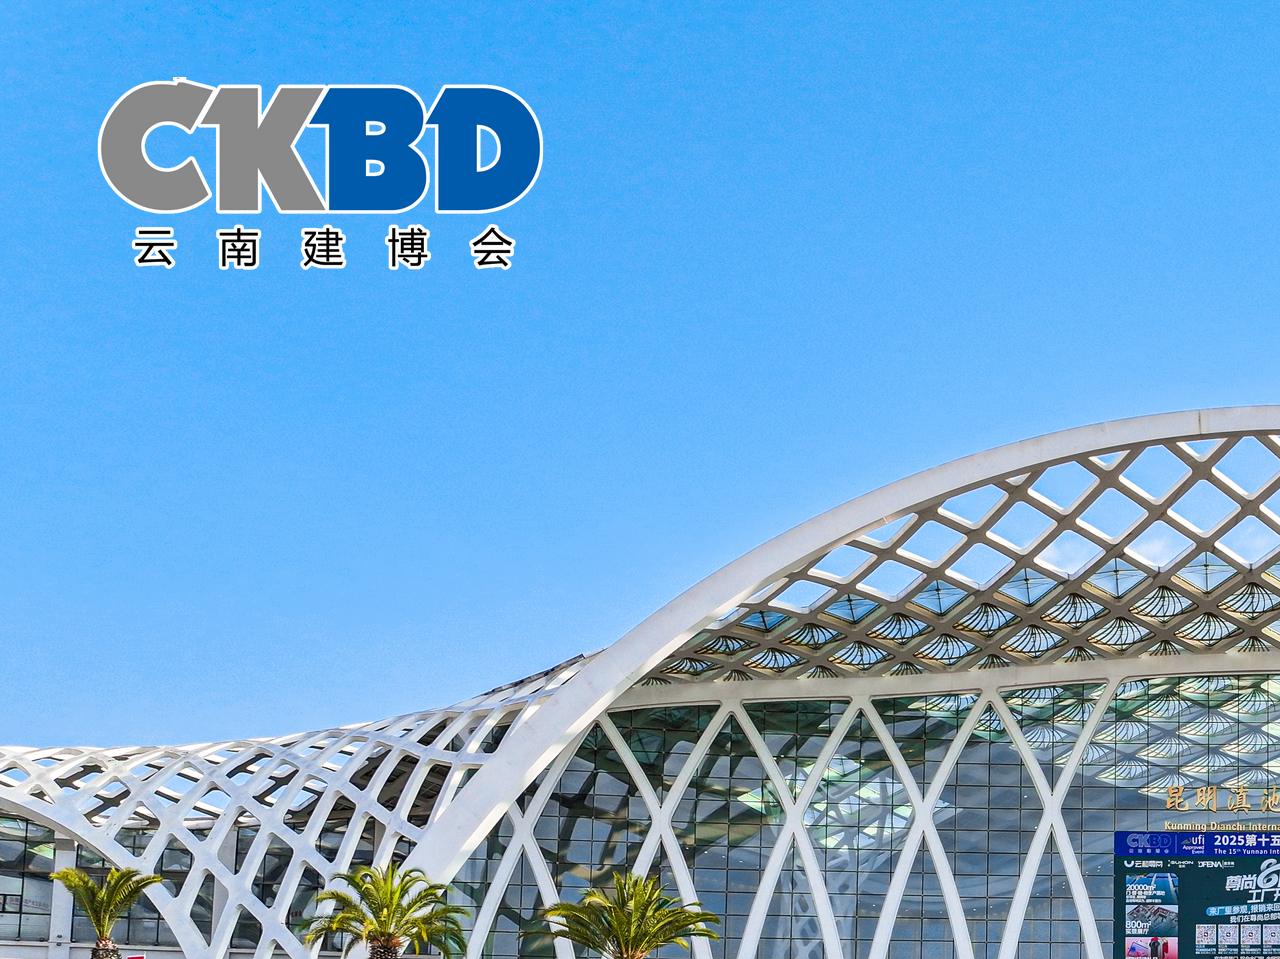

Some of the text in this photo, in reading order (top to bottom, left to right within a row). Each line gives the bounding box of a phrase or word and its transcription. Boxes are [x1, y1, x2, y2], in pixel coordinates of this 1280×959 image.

[1164, 821, 1207, 832] Kunming
[1210, 821, 1245, 831] Dianchi
[1191, 835, 1205, 845] ufi
